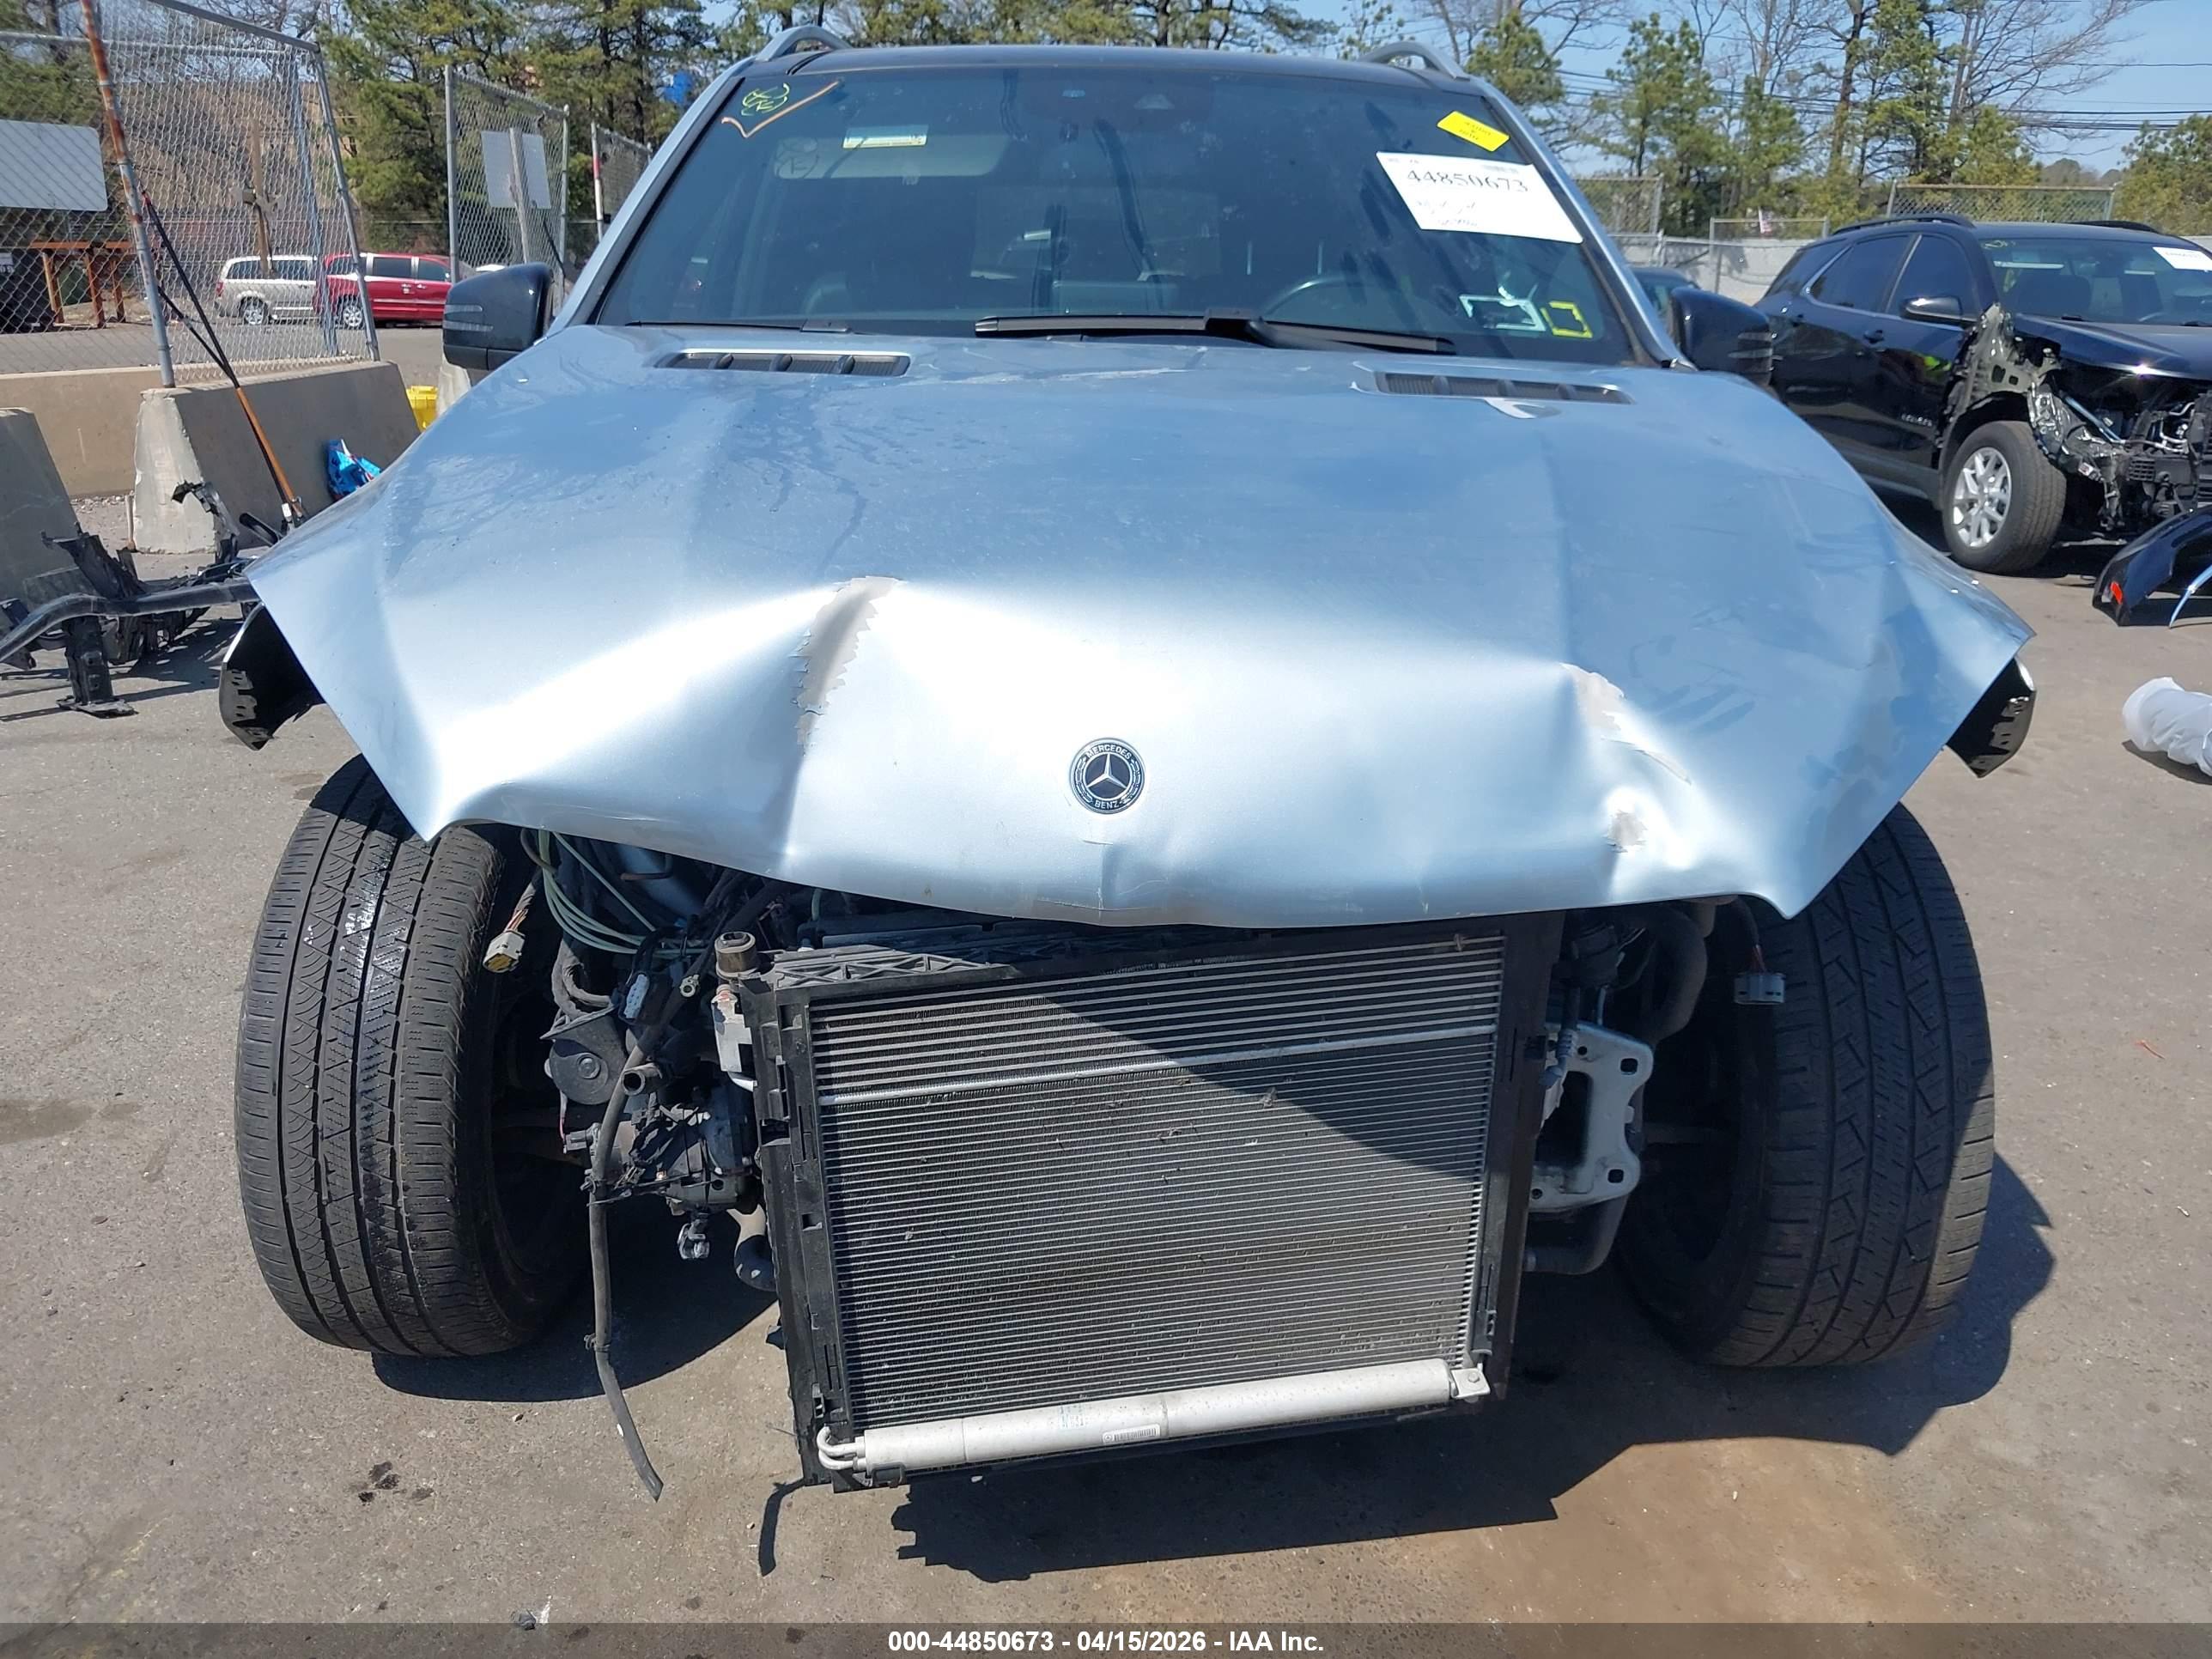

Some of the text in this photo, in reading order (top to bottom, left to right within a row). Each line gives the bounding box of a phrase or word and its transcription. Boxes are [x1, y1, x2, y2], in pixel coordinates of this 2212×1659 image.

[1407, 169, 1529, 192] 44850673
[1085, 744, 1133, 760] MERCEDES
[1094, 799, 1120, 810] BENZ
